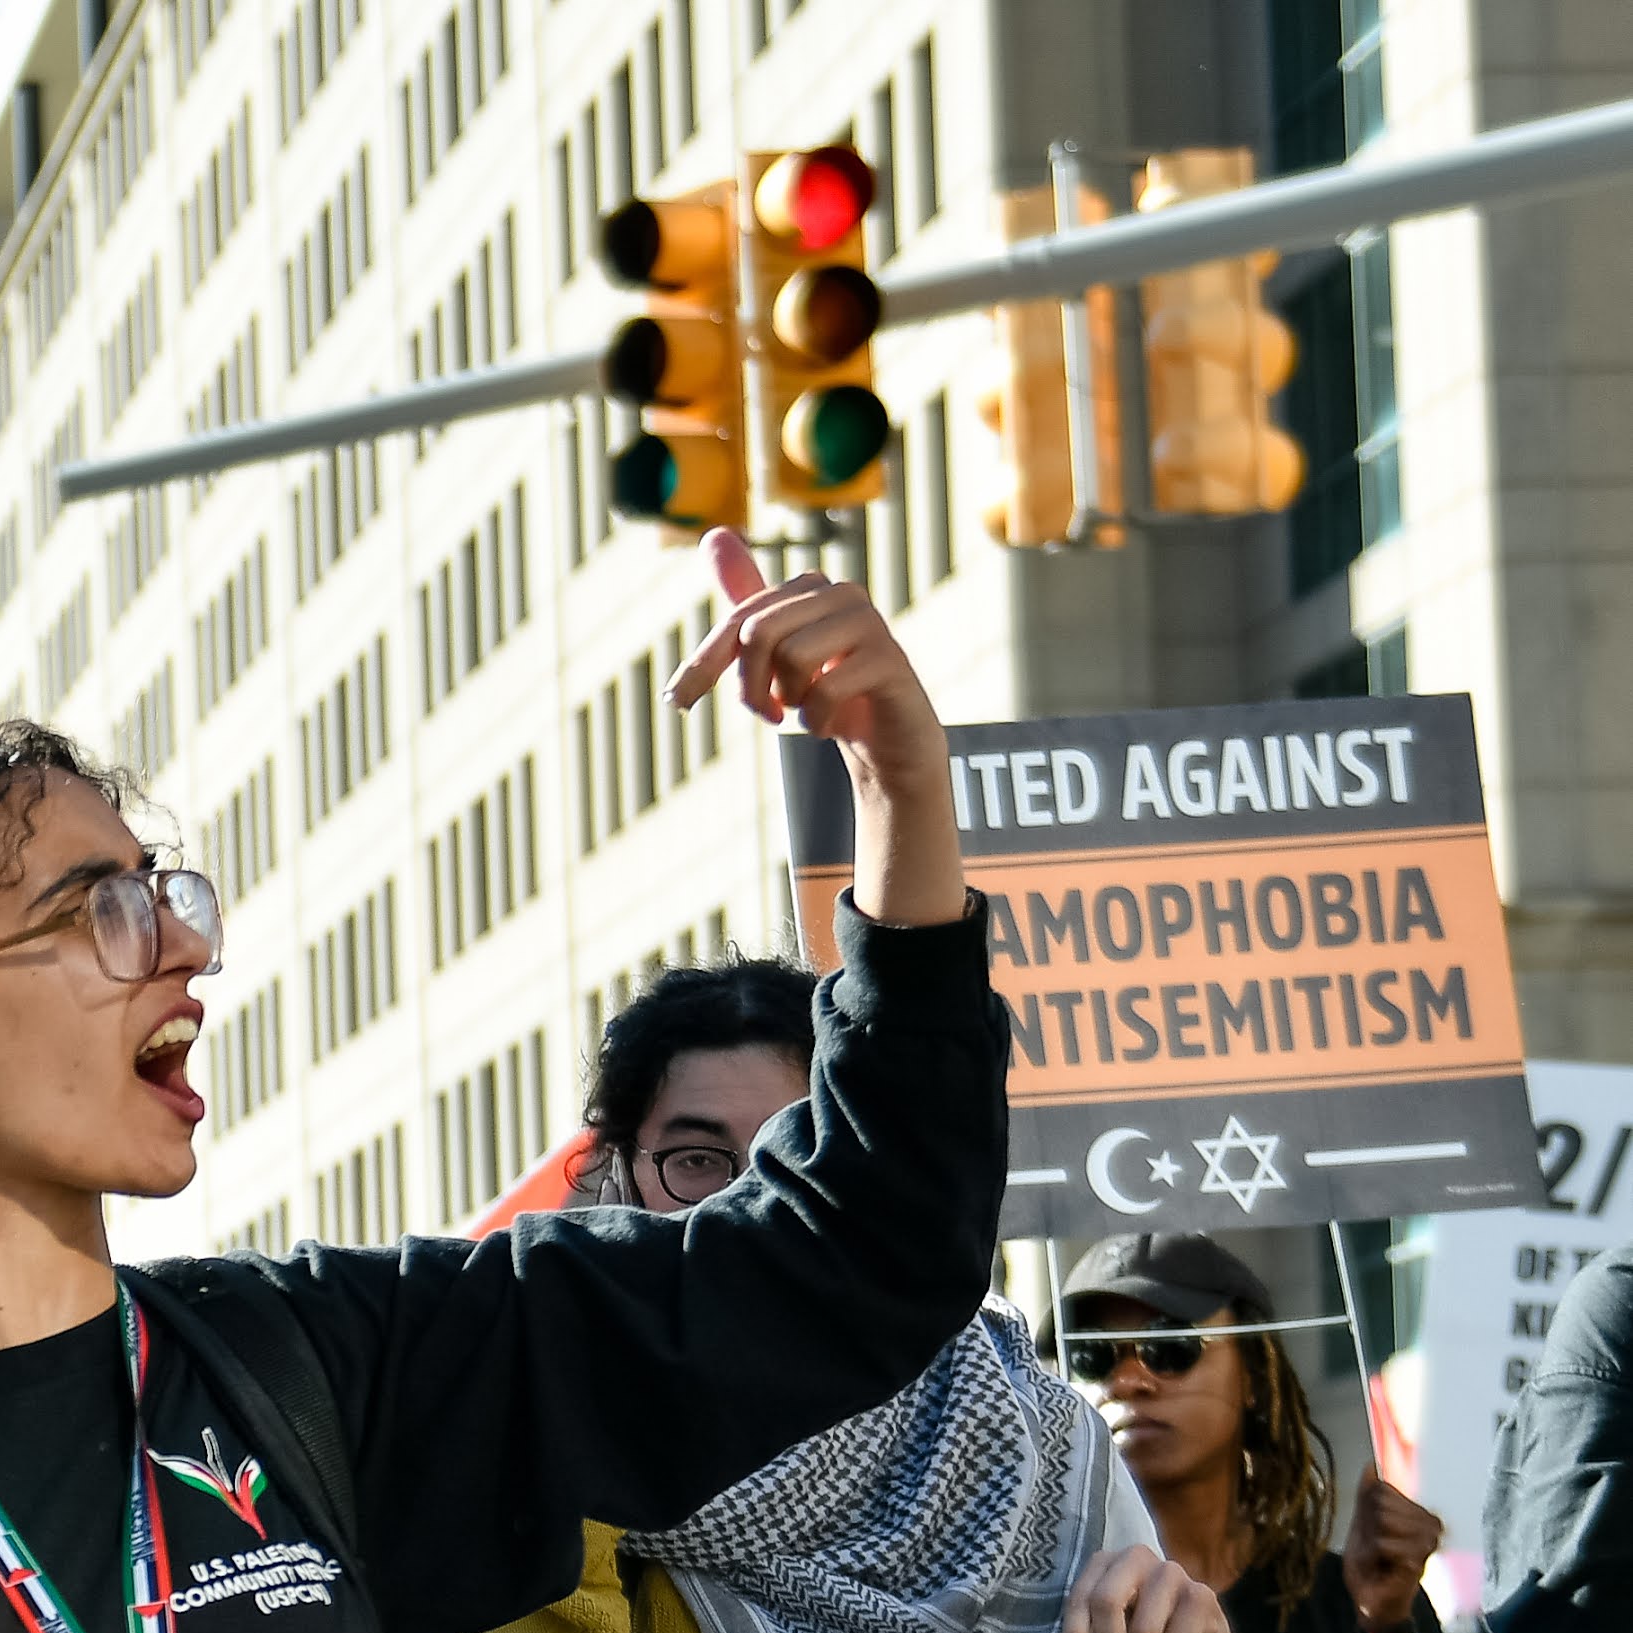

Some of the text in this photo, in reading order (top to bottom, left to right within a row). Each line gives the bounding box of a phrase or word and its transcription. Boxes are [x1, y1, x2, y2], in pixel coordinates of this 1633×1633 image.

[948, 727, 1414, 831] ITED AGAINST
[988, 866, 1446, 968] AMOPHOBIA
[1007, 966, 1474, 1069] NTISEMITISM
[190, 1558, 235, 1583] U.S.
